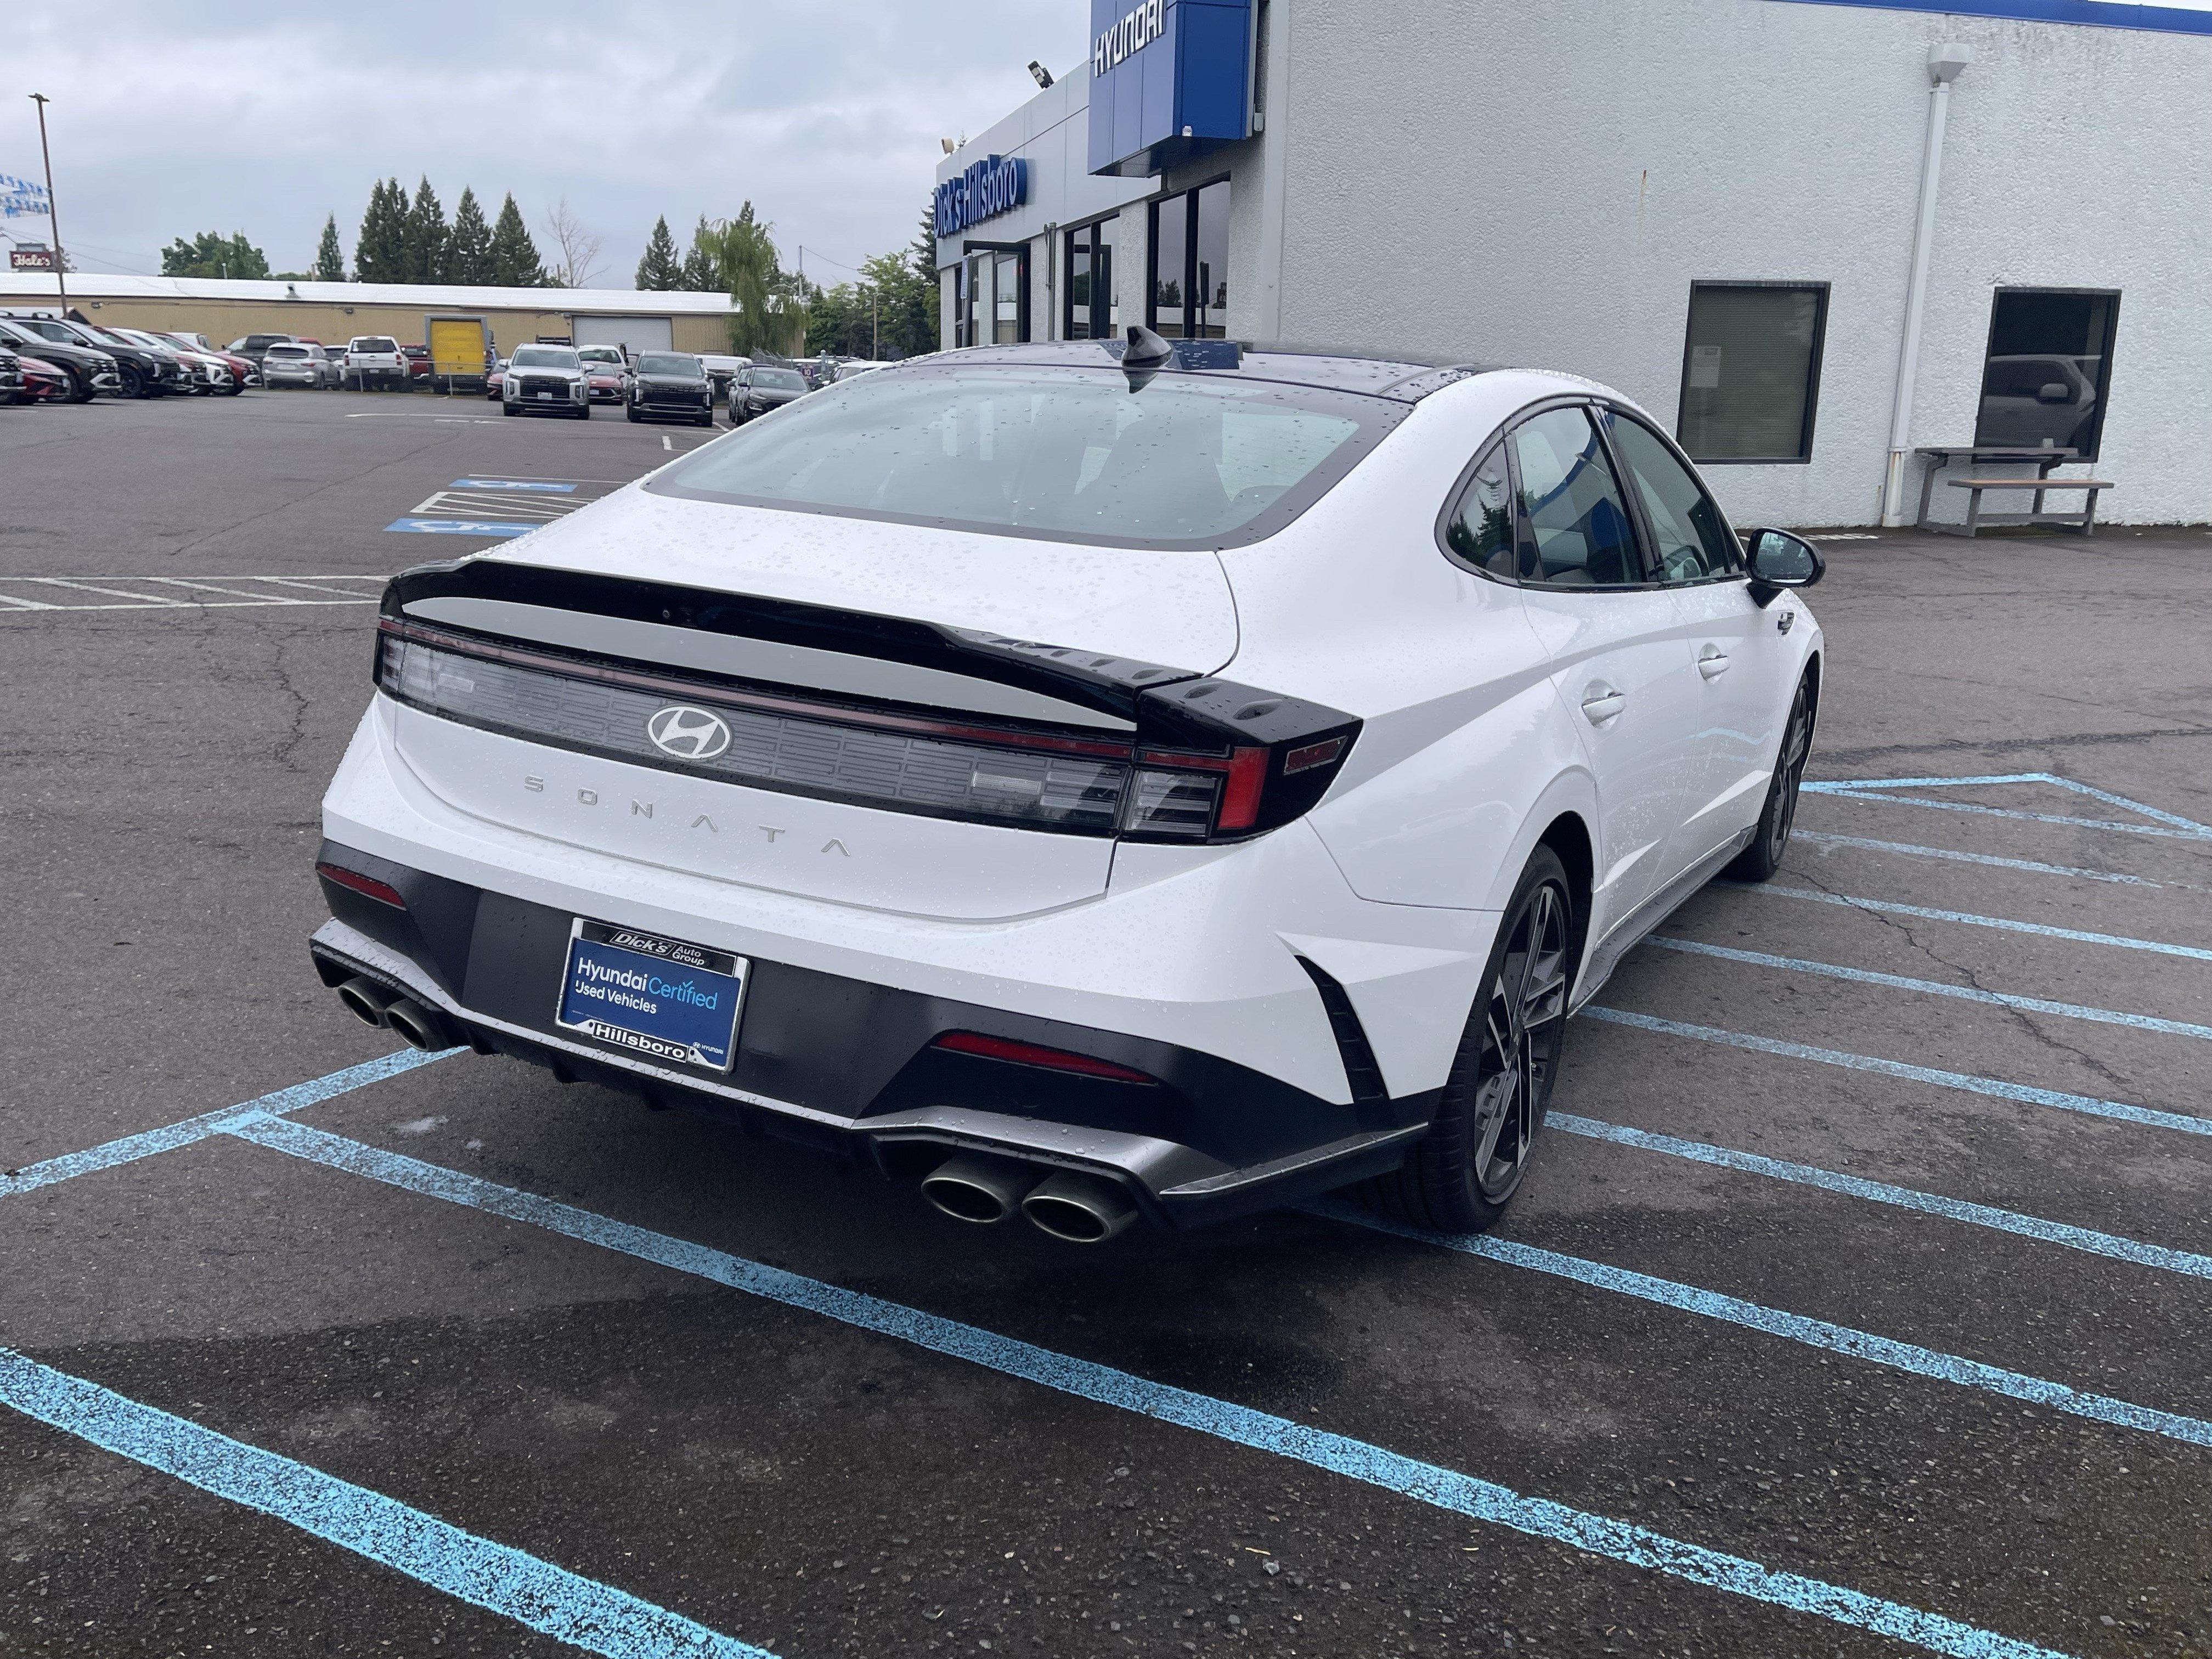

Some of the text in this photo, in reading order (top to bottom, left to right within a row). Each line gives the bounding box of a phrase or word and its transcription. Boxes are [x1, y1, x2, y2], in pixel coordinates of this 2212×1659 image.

[1094, 0, 1164, 77] HYUNDAI
[934, 154, 1019, 238] Dick's Hillsboro
[13, 253, 50, 267] Hale's
[524, 775, 850, 857] SONATA
[614, 933, 668, 953] Dick's
[672, 951, 704, 966] Group
[675, 946, 701, 957] Auto
[575, 980, 657, 1014] Used Vehicles
[578, 957, 718, 1011] Hyundai Certified
[596, 1024, 685, 1058] Hillsboro
[701, 1044, 724, 1055] HYUNDAI
